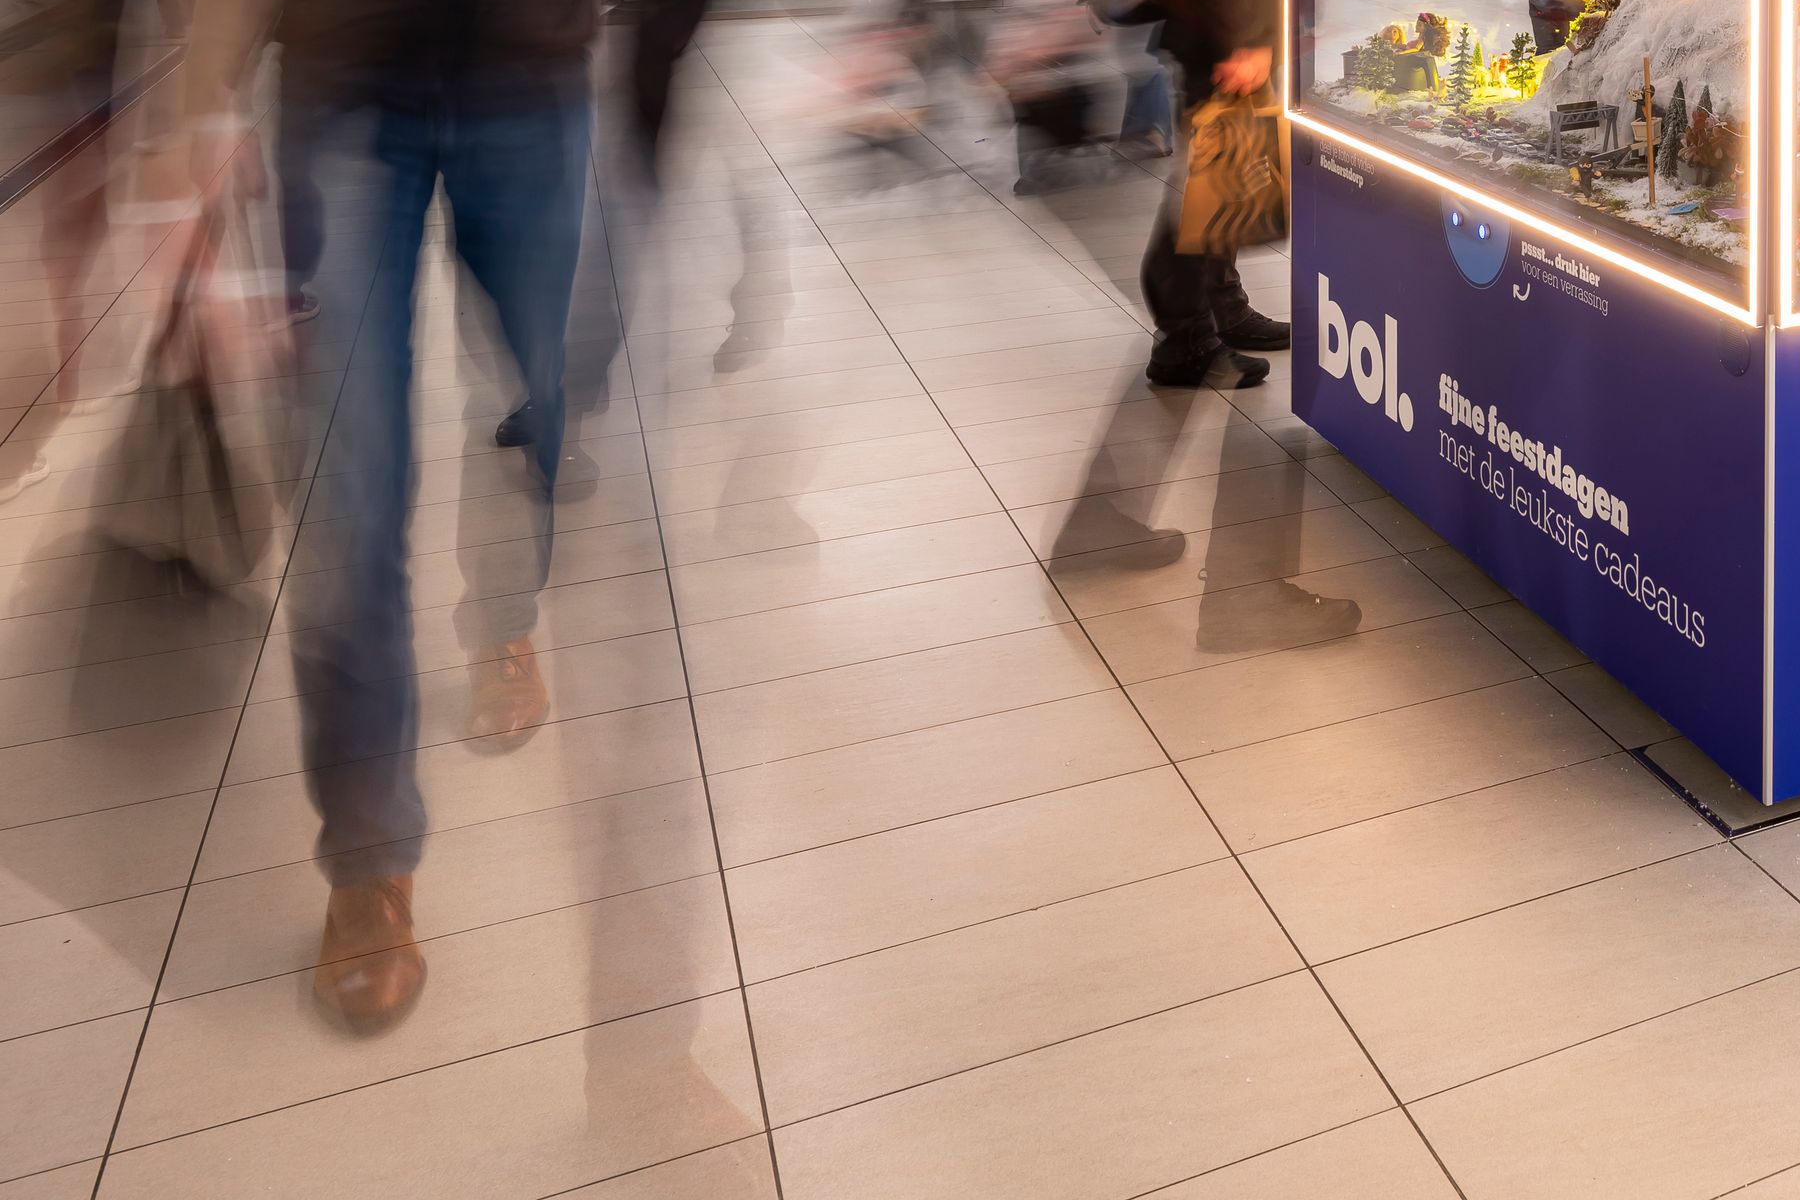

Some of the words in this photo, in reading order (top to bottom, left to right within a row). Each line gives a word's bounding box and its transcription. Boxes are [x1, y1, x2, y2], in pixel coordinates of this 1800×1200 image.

[1521, 240, 1554, 267] pssst...
[1554, 252, 1579, 278] druk
[1579, 262, 1601, 288] hier
[1521, 260, 1541, 280] voor
[1542, 270, 1559, 289] een
[1559, 278, 1609, 317] verrassing
[1318, 271, 1414, 432] bol.
[1438, 372, 1485, 436] fijne
[1487, 404, 1630, 537] feestdagen
[1439, 428, 1476, 482] met
[1479, 451, 1506, 501] de
[1509, 466, 1589, 562] leukste
[1594, 542, 1706, 649] cadeaus
